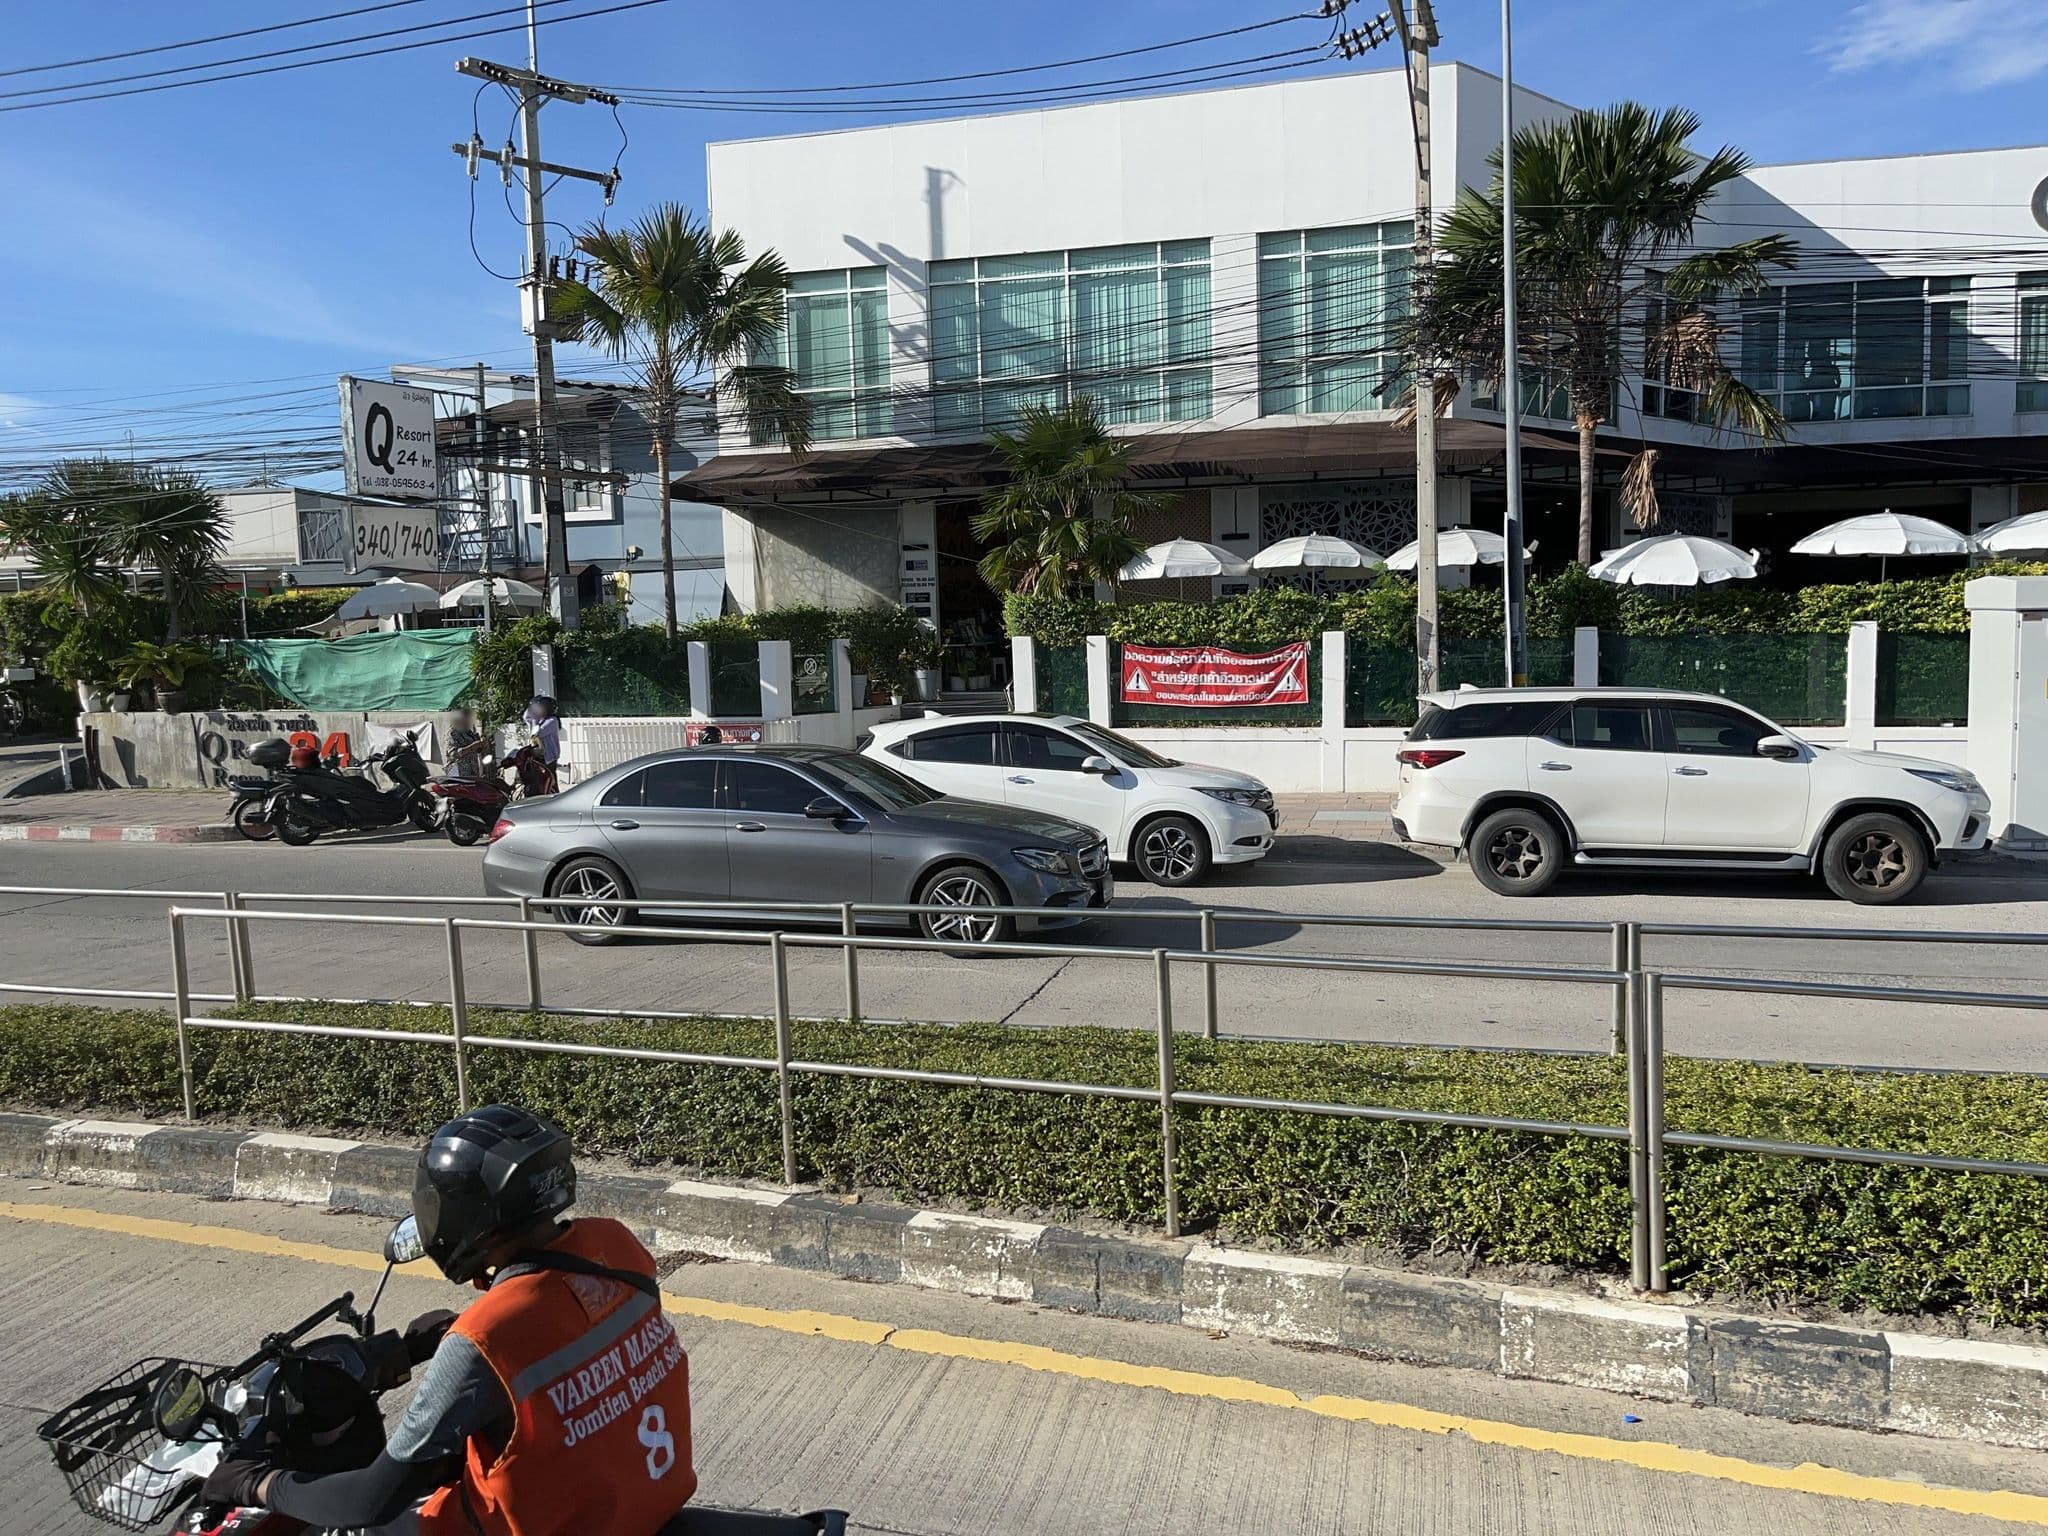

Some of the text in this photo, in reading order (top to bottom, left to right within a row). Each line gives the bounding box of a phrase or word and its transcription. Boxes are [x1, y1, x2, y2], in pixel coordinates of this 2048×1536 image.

[365, 402, 432, 475] Q Resort
[396, 450, 436, 469] 24 hr.
[362, 476, 373, 486] Tel
[547, 1347, 625, 1415] VAREEN
[563, 1395, 631, 1447] Jomtien
[628, 1357, 666, 1401] Beach
[637, 1404, 675, 1480] 8
